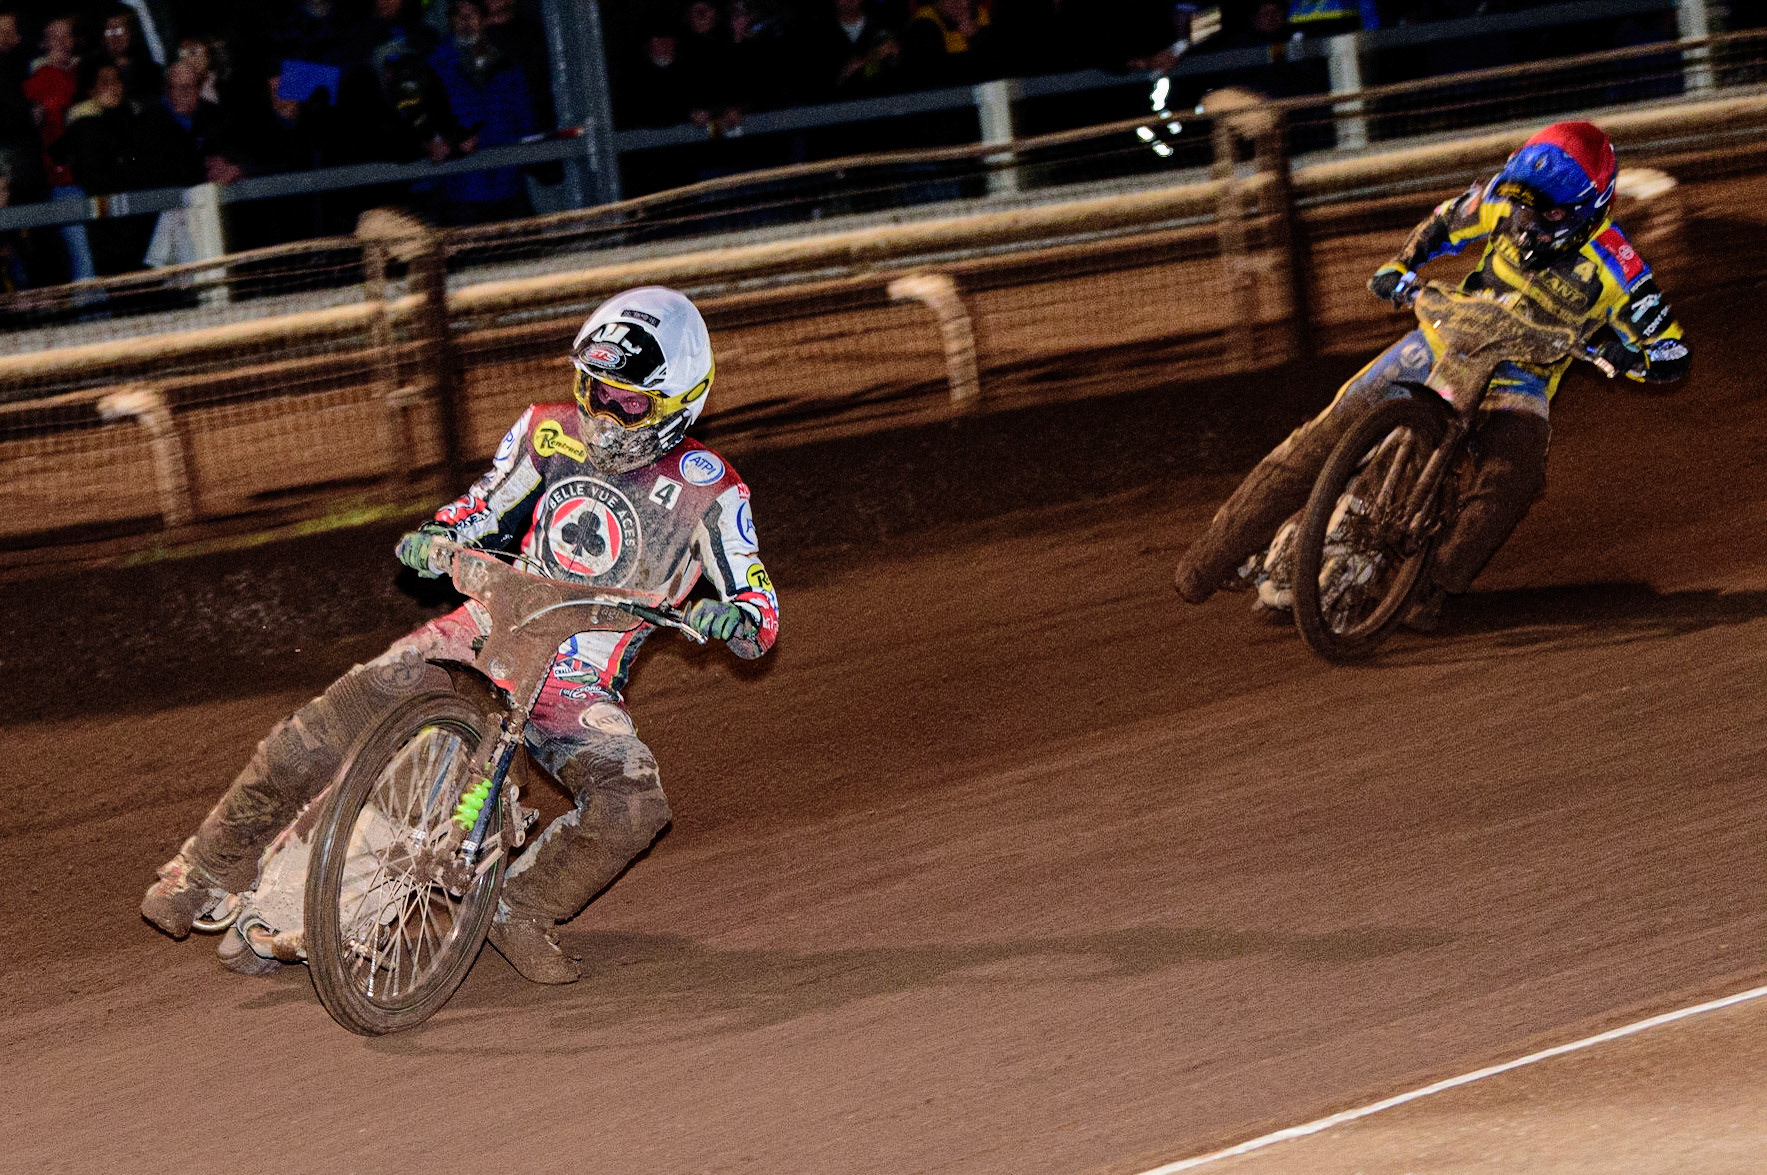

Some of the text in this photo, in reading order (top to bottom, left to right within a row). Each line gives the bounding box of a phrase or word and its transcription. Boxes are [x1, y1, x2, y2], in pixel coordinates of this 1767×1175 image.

[689, 456, 716, 476] ATPI
[655, 483, 676, 505] 4
[549, 484, 635, 547] BELLE VUE ACES
